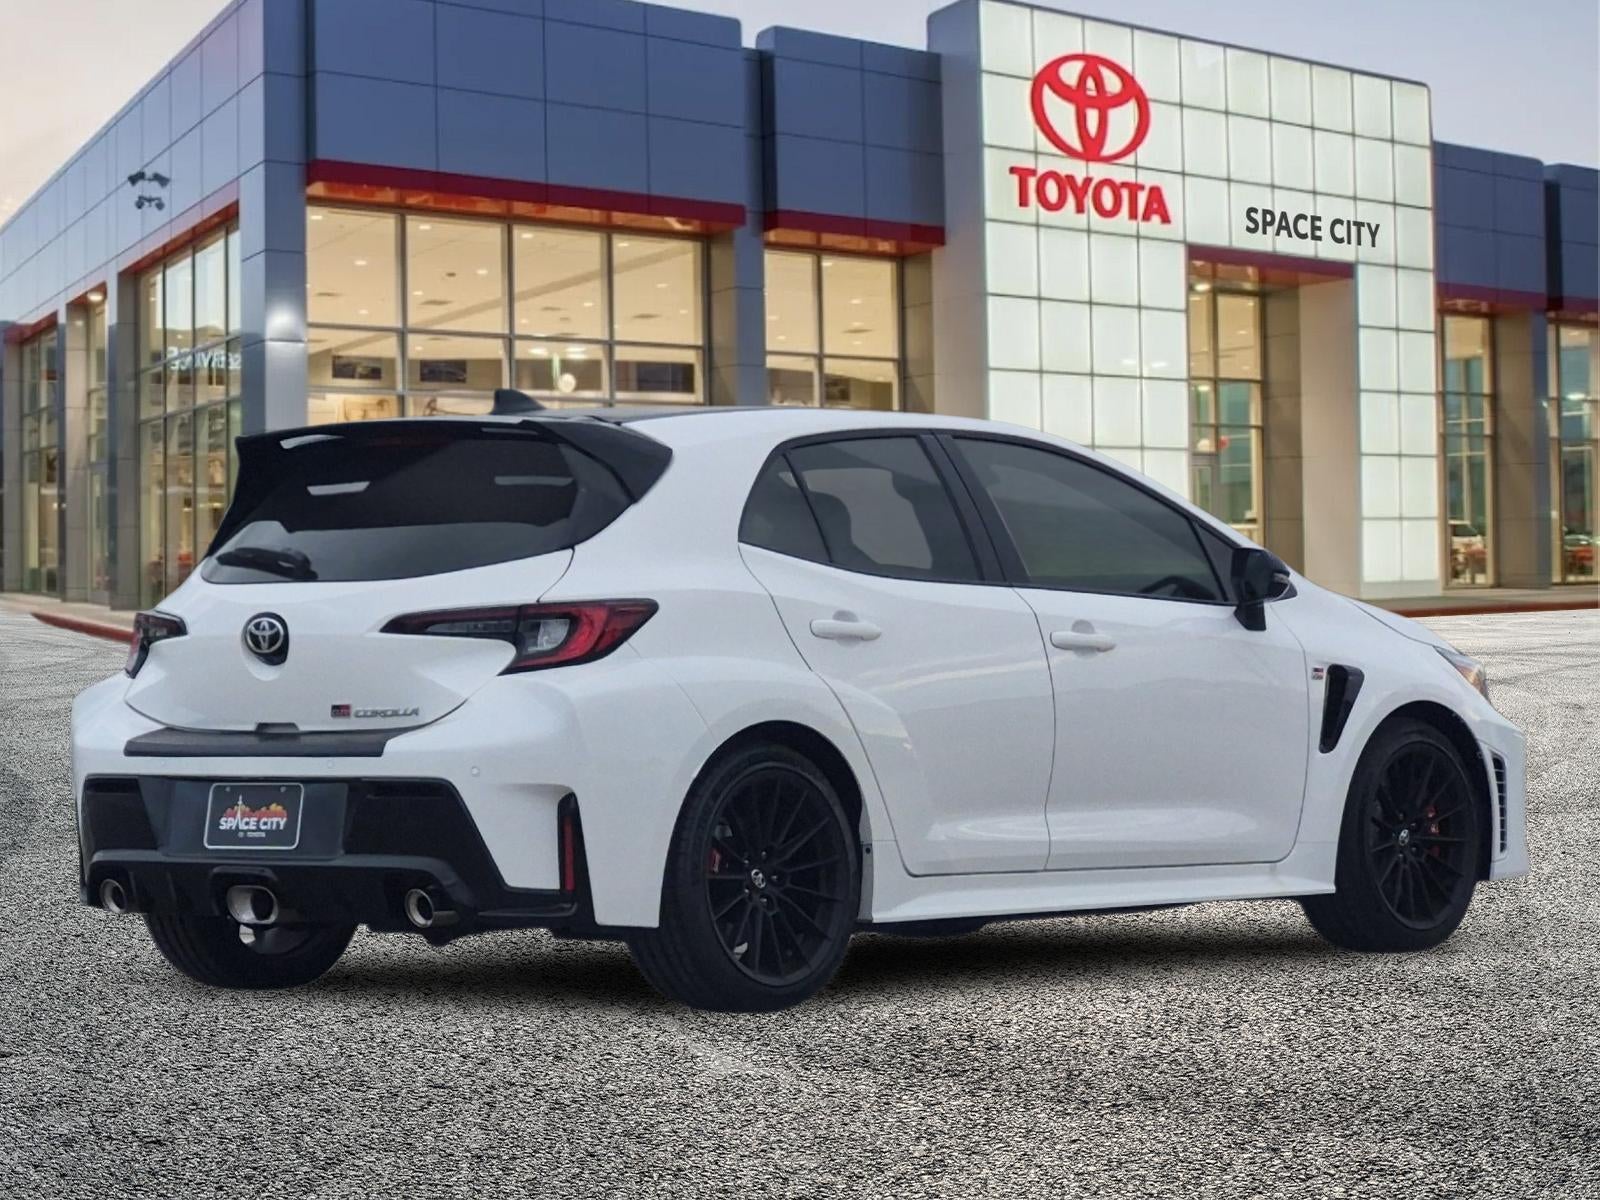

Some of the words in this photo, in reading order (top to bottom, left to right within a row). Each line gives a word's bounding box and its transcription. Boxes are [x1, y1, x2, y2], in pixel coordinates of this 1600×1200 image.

[1009, 166, 1171, 224] TOYOTA
[1245, 207, 1322, 241] SPACE
[1330, 218, 1380, 248] CITY
[354, 708, 419, 718] COROLLA
[219, 817, 257, 830] SPACE
[259, 817, 286, 830] CITY
